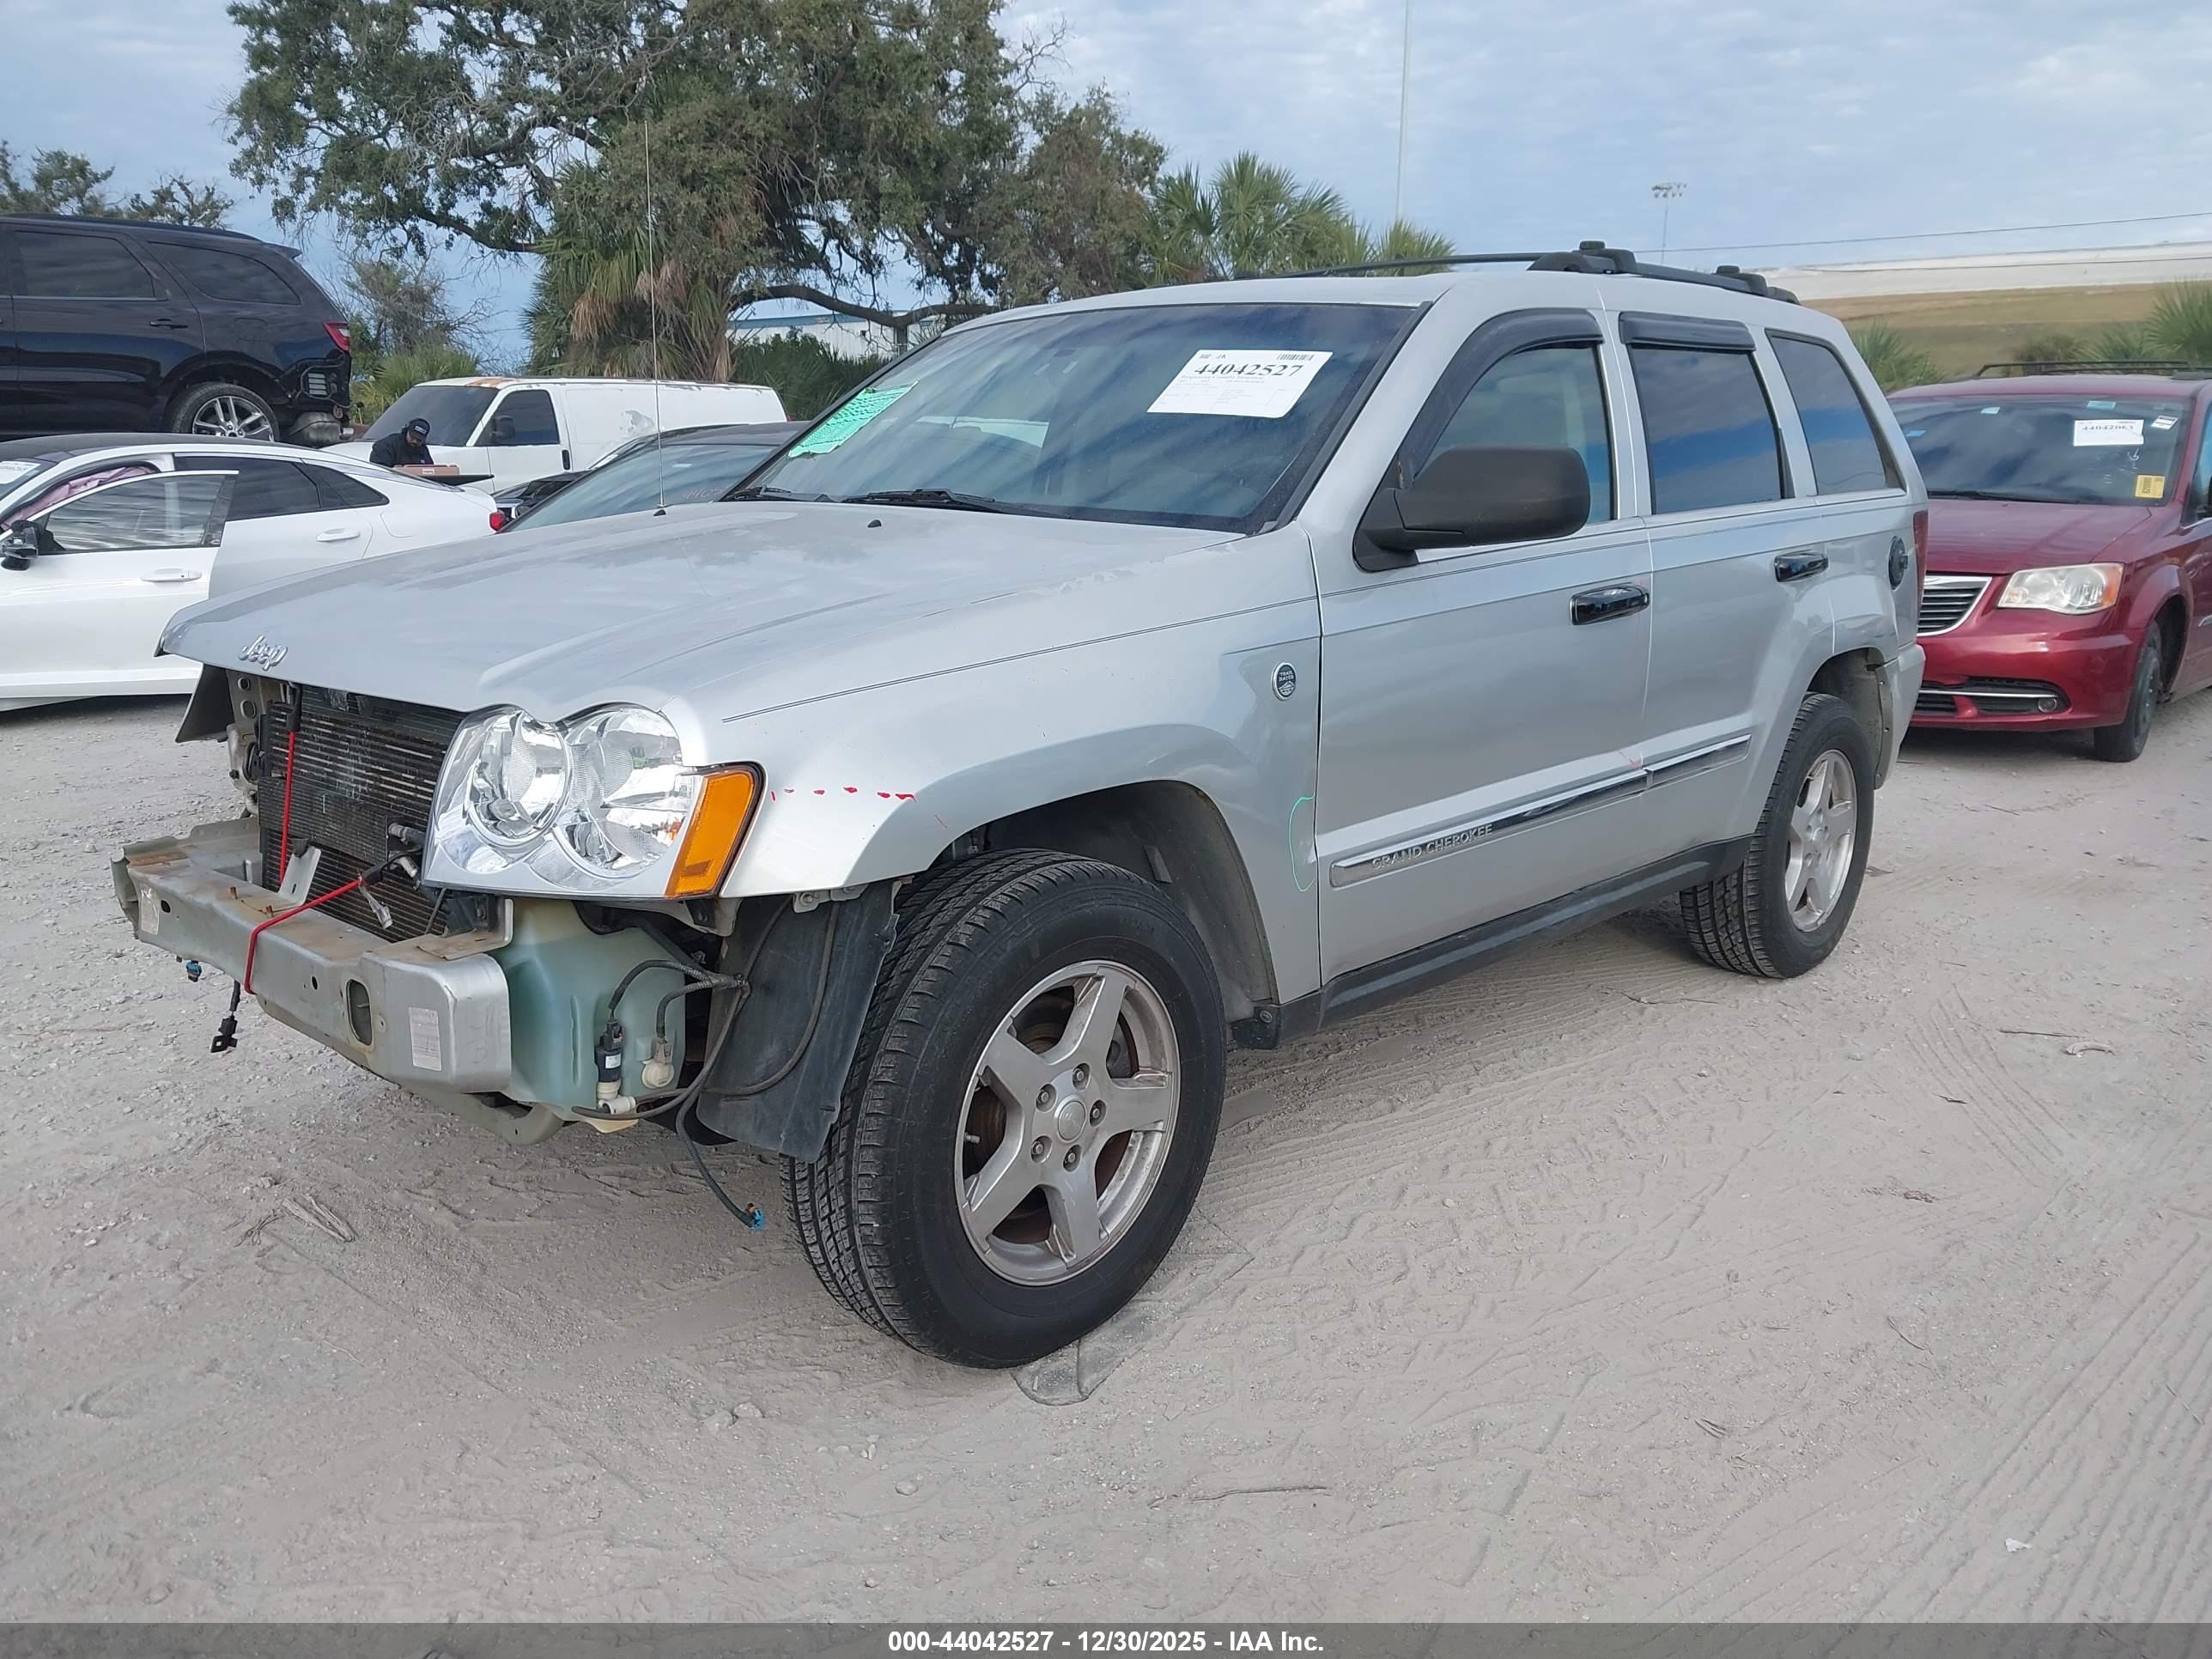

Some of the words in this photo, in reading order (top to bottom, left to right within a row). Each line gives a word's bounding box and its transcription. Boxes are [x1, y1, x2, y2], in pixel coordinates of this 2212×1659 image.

[1194, 363, 1304, 377] 44042527
[238, 635, 289, 672] Jeep
[1372, 846, 1423, 870] GRAND
[1425, 823, 1493, 854] CHEROKEE
